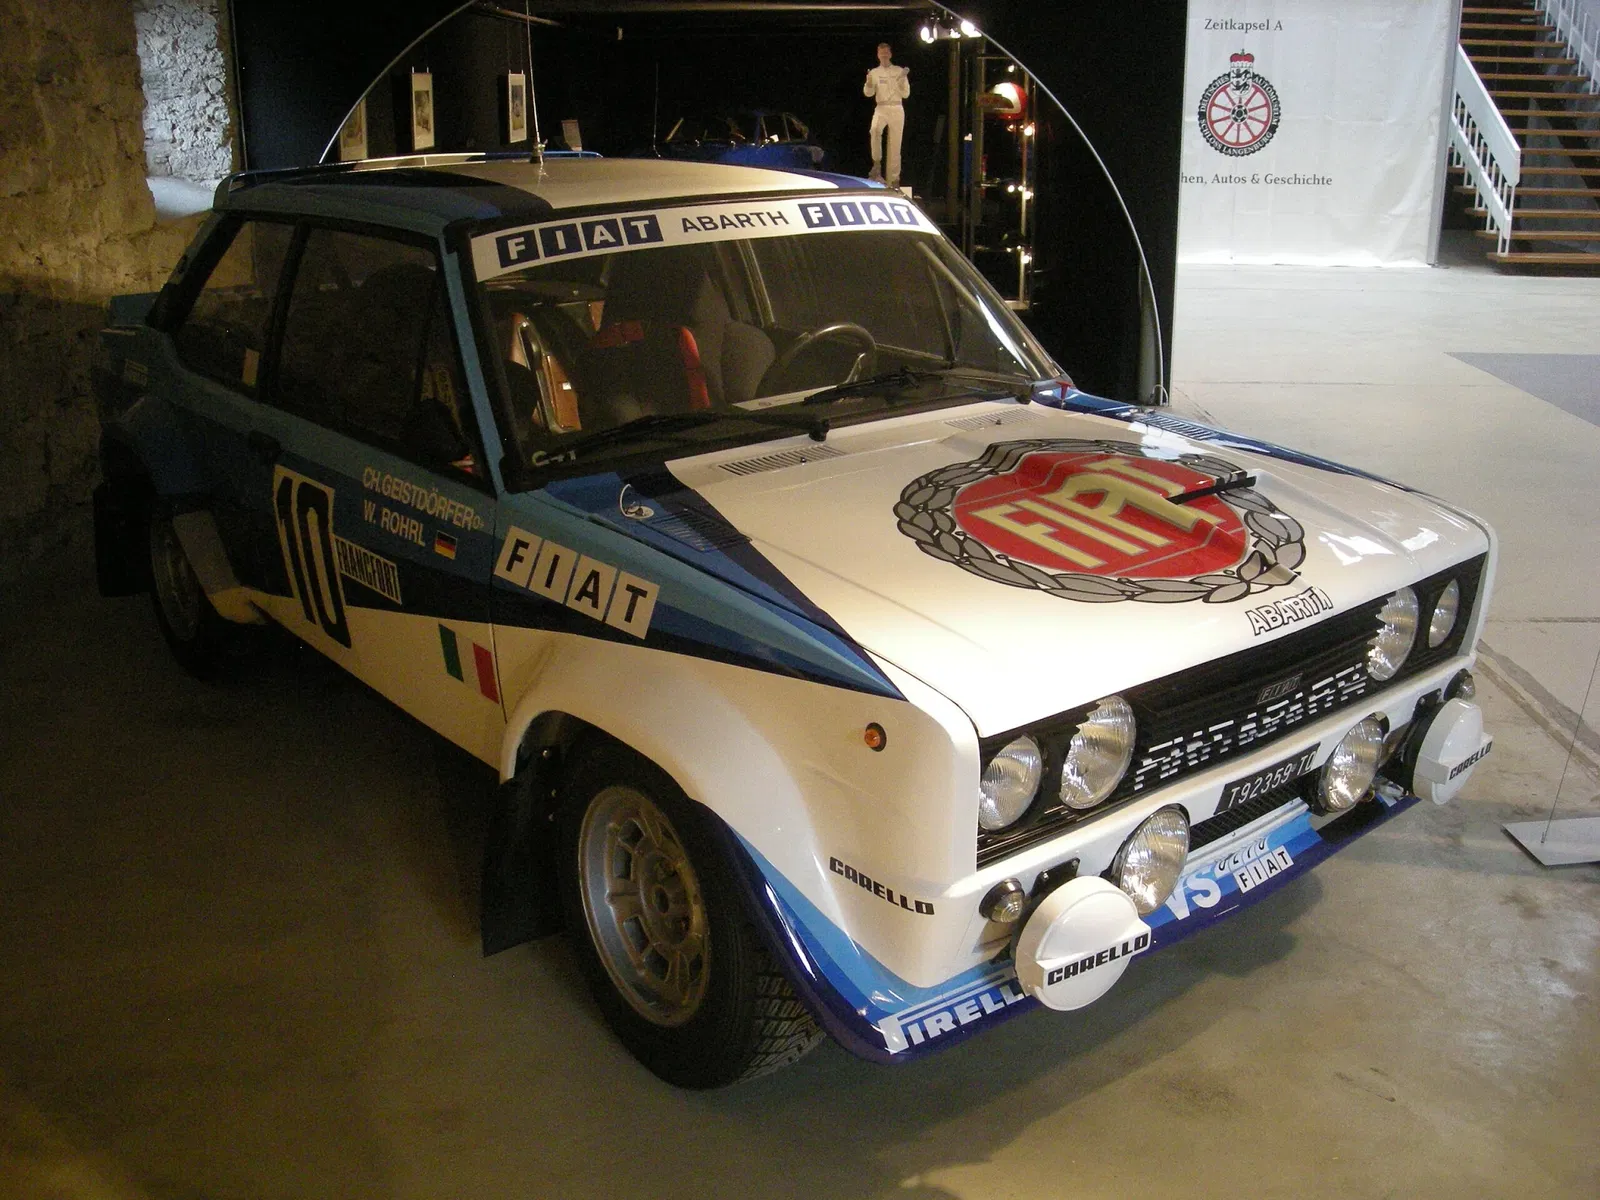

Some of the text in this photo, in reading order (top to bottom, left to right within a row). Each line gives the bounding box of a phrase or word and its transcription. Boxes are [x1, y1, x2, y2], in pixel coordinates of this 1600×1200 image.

[1204, 18, 1283, 34] Zeitkapsel A
[1200, 75, 1229, 112] DEUTSCHES
[1200, 119, 1273, 155] SCHLOSS LANGENBURG
[1211, 173, 1247, 184] Autos
[1251, 173, 1260, 184] &
[1264, 173, 1333, 186] Geschichte
[502, 203, 916, 264] FIAT ABARTH FIAT
[363, 500, 427, 547] W. ROHRL
[970, 457, 1226, 569] FIAT
[275, 475, 352, 649] 10
[501, 534, 653, 629] FIAT
[1244, 586, 1334, 636] ABARTH
[1449, 741, 1493, 780] CARELLO
[1228, 763, 1292, 808] T92359
[829, 856, 935, 916] CARELLO
[1236, 848, 1291, 890] FIAT
[1047, 933, 1149, 986] CARELLO
[878, 966, 1031, 1055] PIRELL
